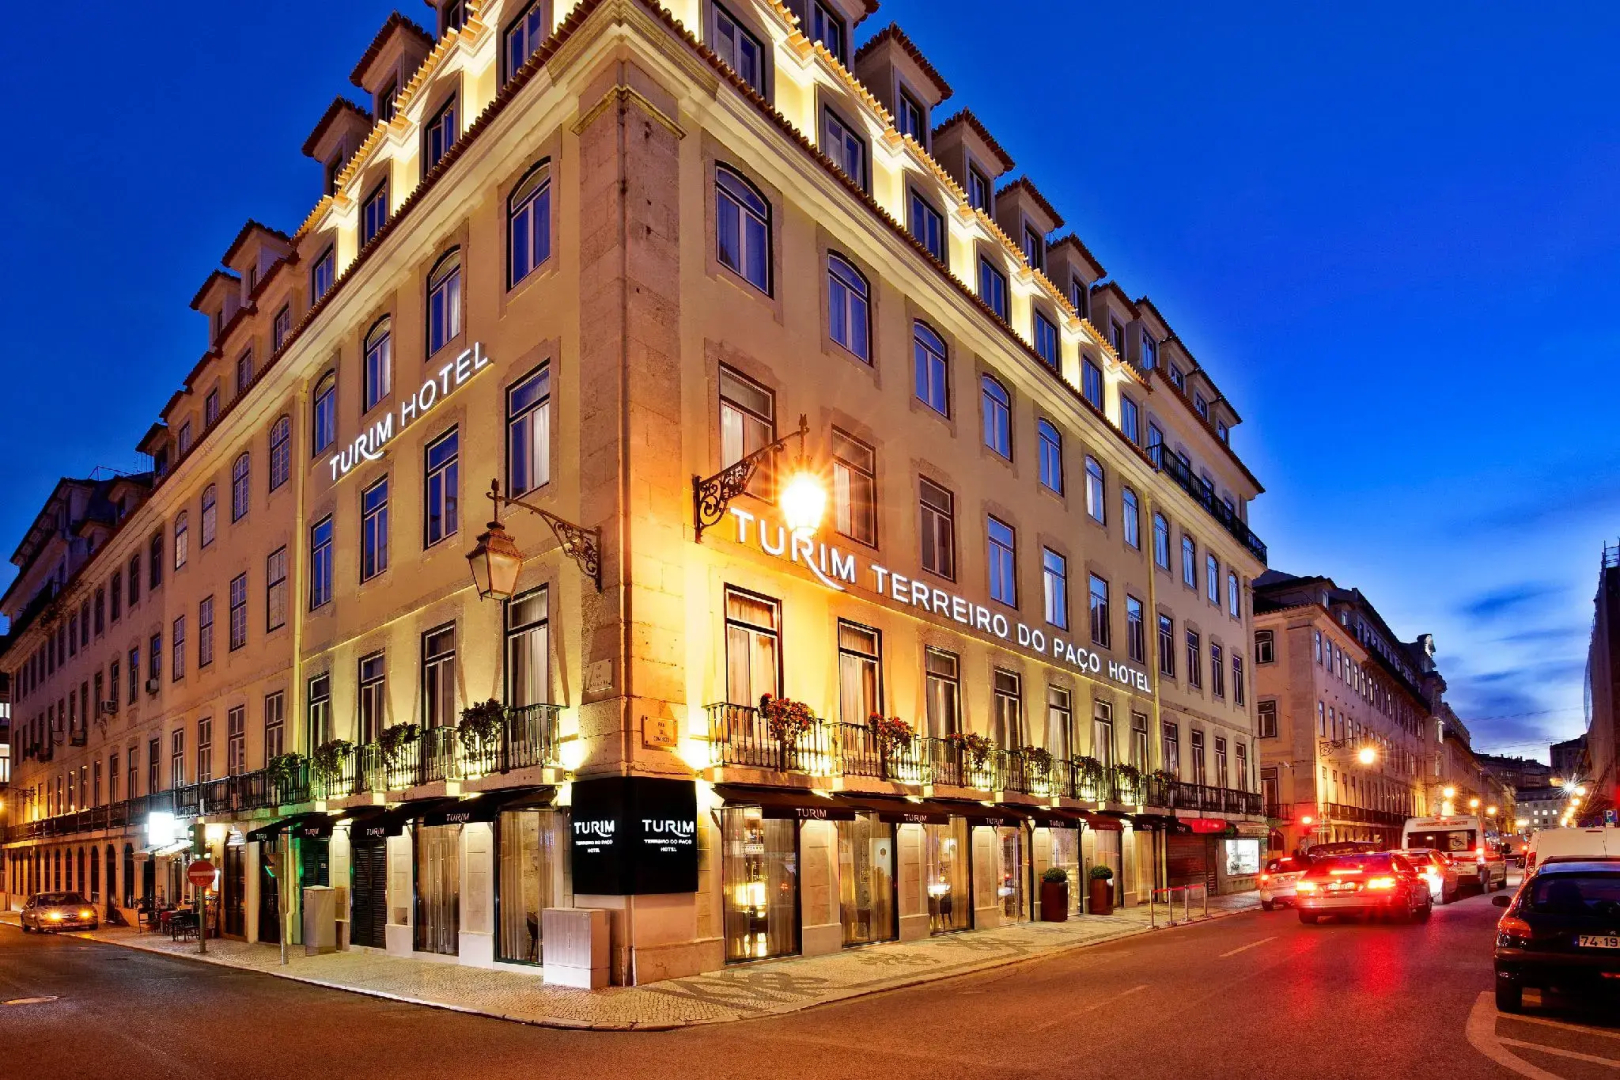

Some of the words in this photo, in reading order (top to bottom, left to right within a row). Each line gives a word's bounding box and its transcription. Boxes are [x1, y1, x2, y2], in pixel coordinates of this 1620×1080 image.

[329, 412, 393, 481] TURIM
[401, 341, 488, 426] HOTEL
[730, 507, 856, 591] TURIM
[871, 564, 1008, 638] TERREIRO
[1017, 623, 1045, 652] DO
[1054, 637, 1100, 673] PAÇO
[1108, 660, 1152, 693] HOTEL
[446, 812, 470, 823] TURIM
[795, 808, 827, 819] TURIM
[903, 813, 927, 823] TURIM
[1606, 810, 1613, 820] P
[985, 817, 1004, 827] TURIM
[574, 820, 615, 837] TURIM
[642, 819, 695, 837] TURIM
